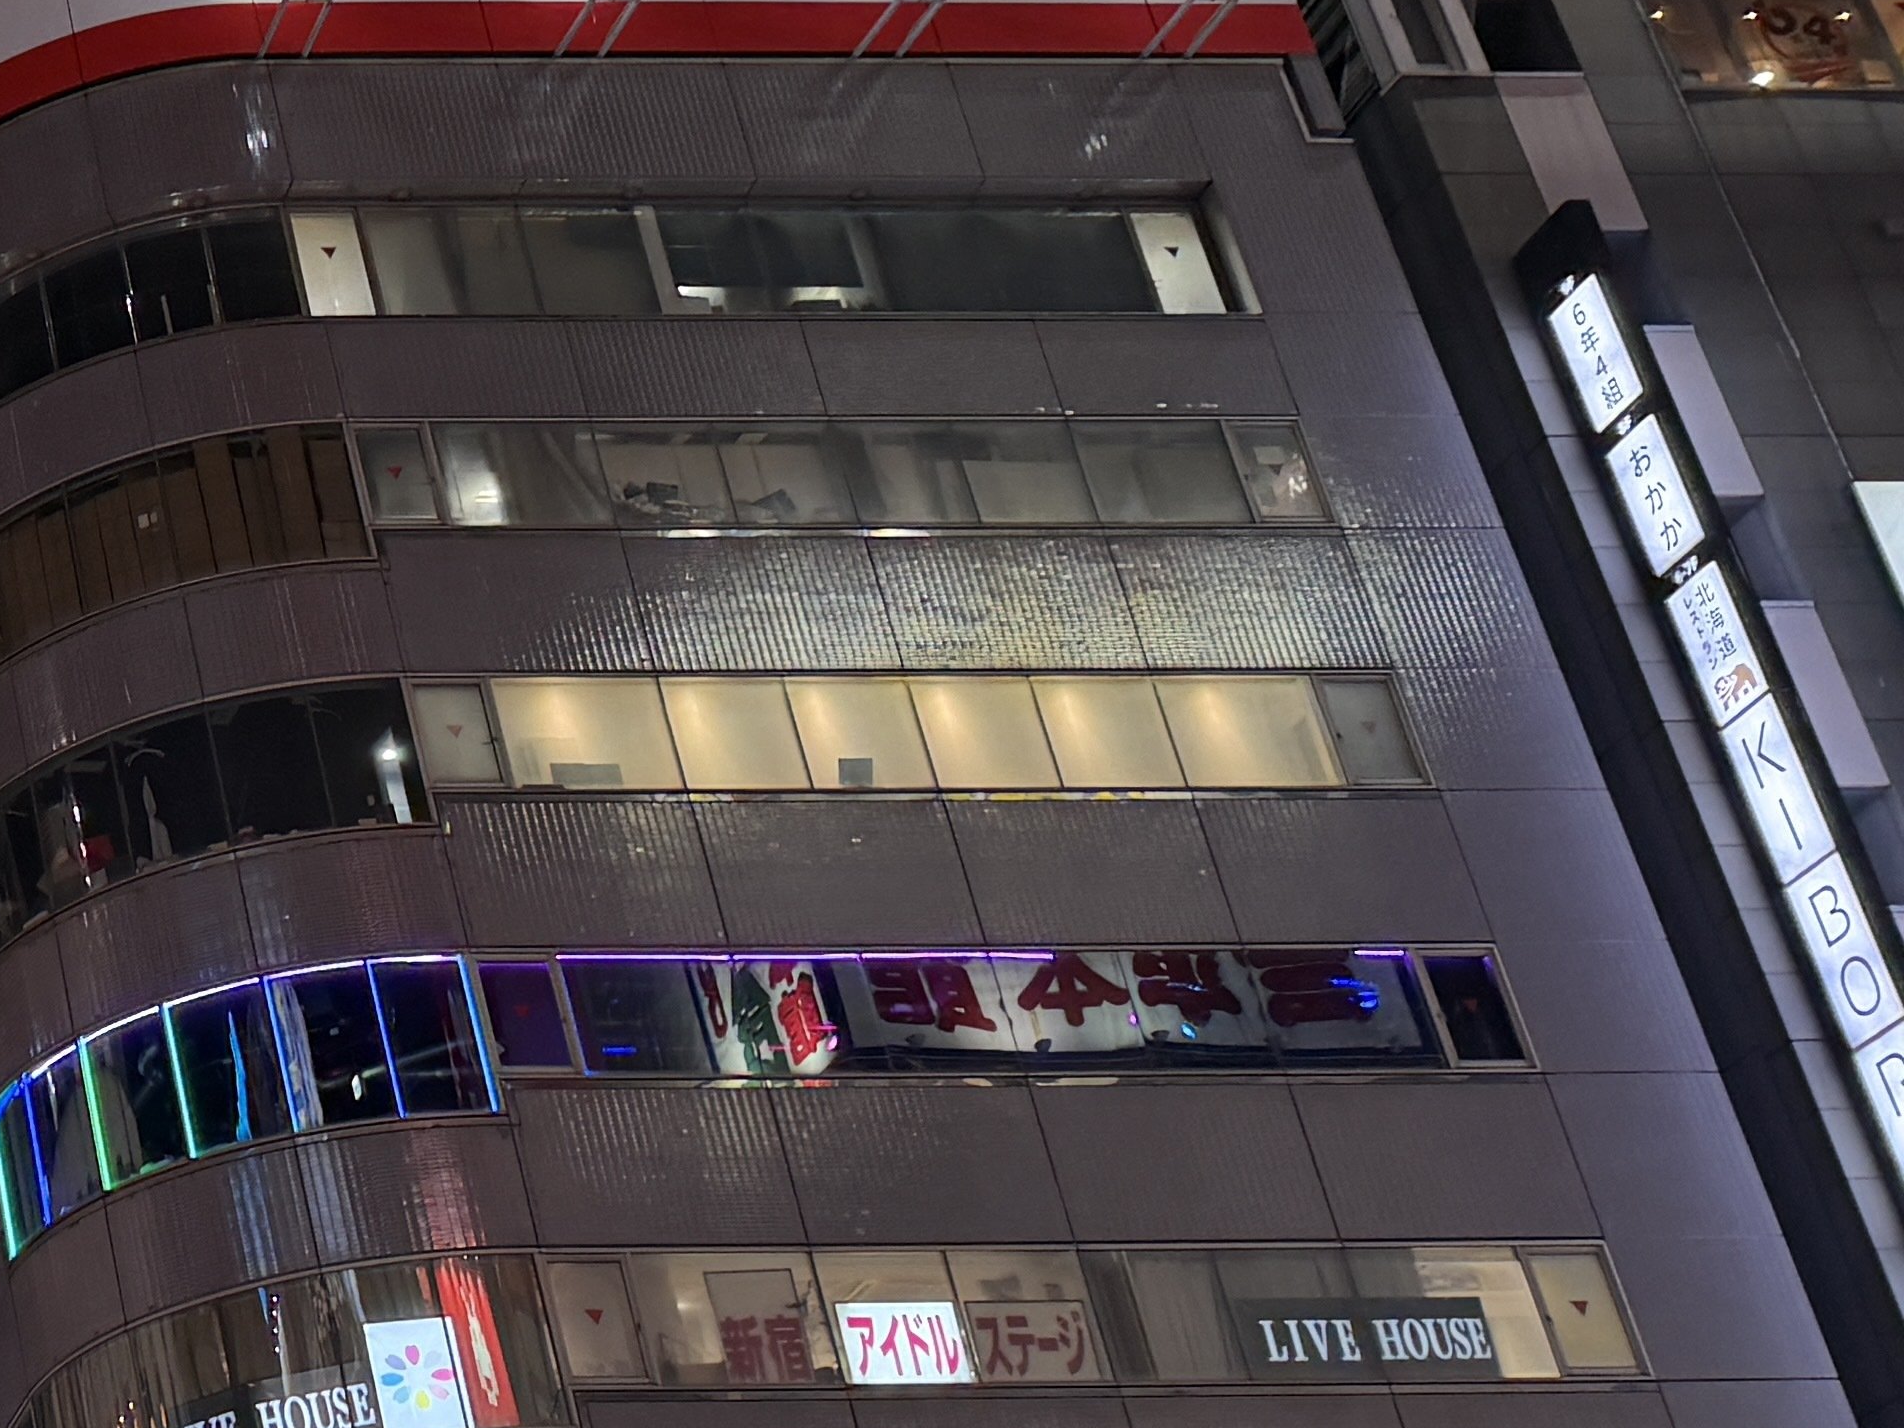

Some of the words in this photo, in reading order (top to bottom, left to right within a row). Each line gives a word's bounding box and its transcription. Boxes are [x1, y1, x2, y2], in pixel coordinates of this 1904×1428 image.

[1572, 303, 1625, 410] 6年4組
[1629, 446, 1683, 551] おかか
[1694, 582, 1738, 657] 北海道
[845, 1314, 960, 1380] アイドル
[978, 1312, 1087, 1378] ステージ
[1259, 1321, 1356, 1363] LIVE
[1372, 1317, 1492, 1361] HOUSE
